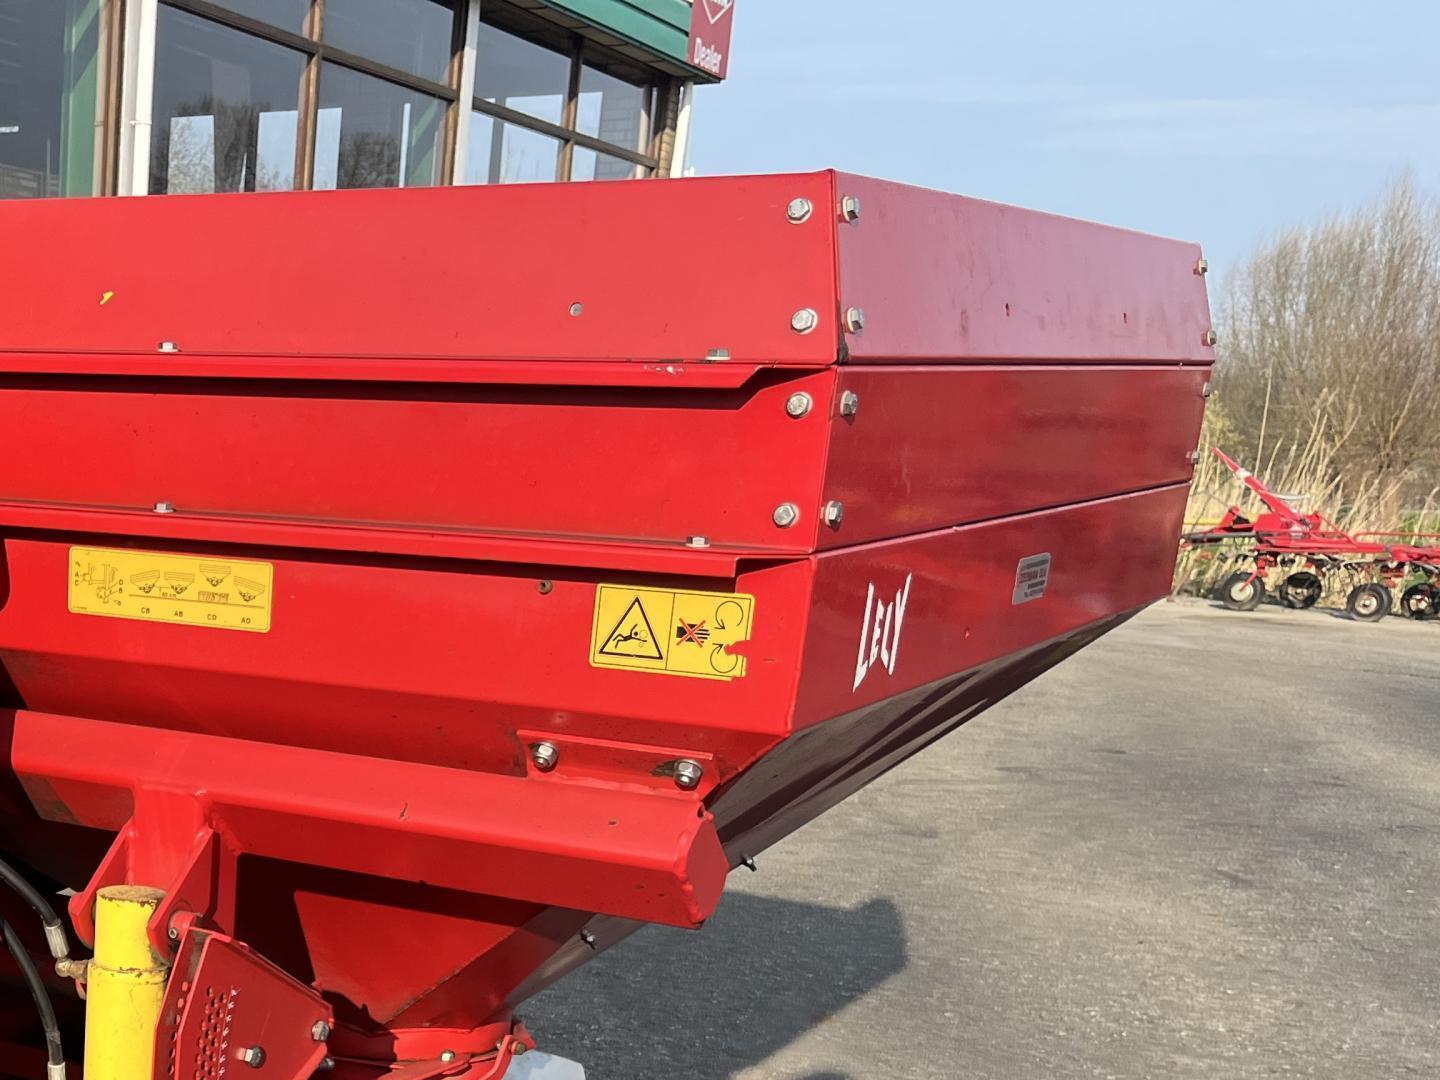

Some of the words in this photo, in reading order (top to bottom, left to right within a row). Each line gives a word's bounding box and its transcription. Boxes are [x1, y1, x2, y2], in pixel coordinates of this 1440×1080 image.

[694, 37, 722, 73] Dealer
[173, 610, 183, 618] AB
[206, 613, 217, 621] CD
[852, 571, 912, 694] LELY
